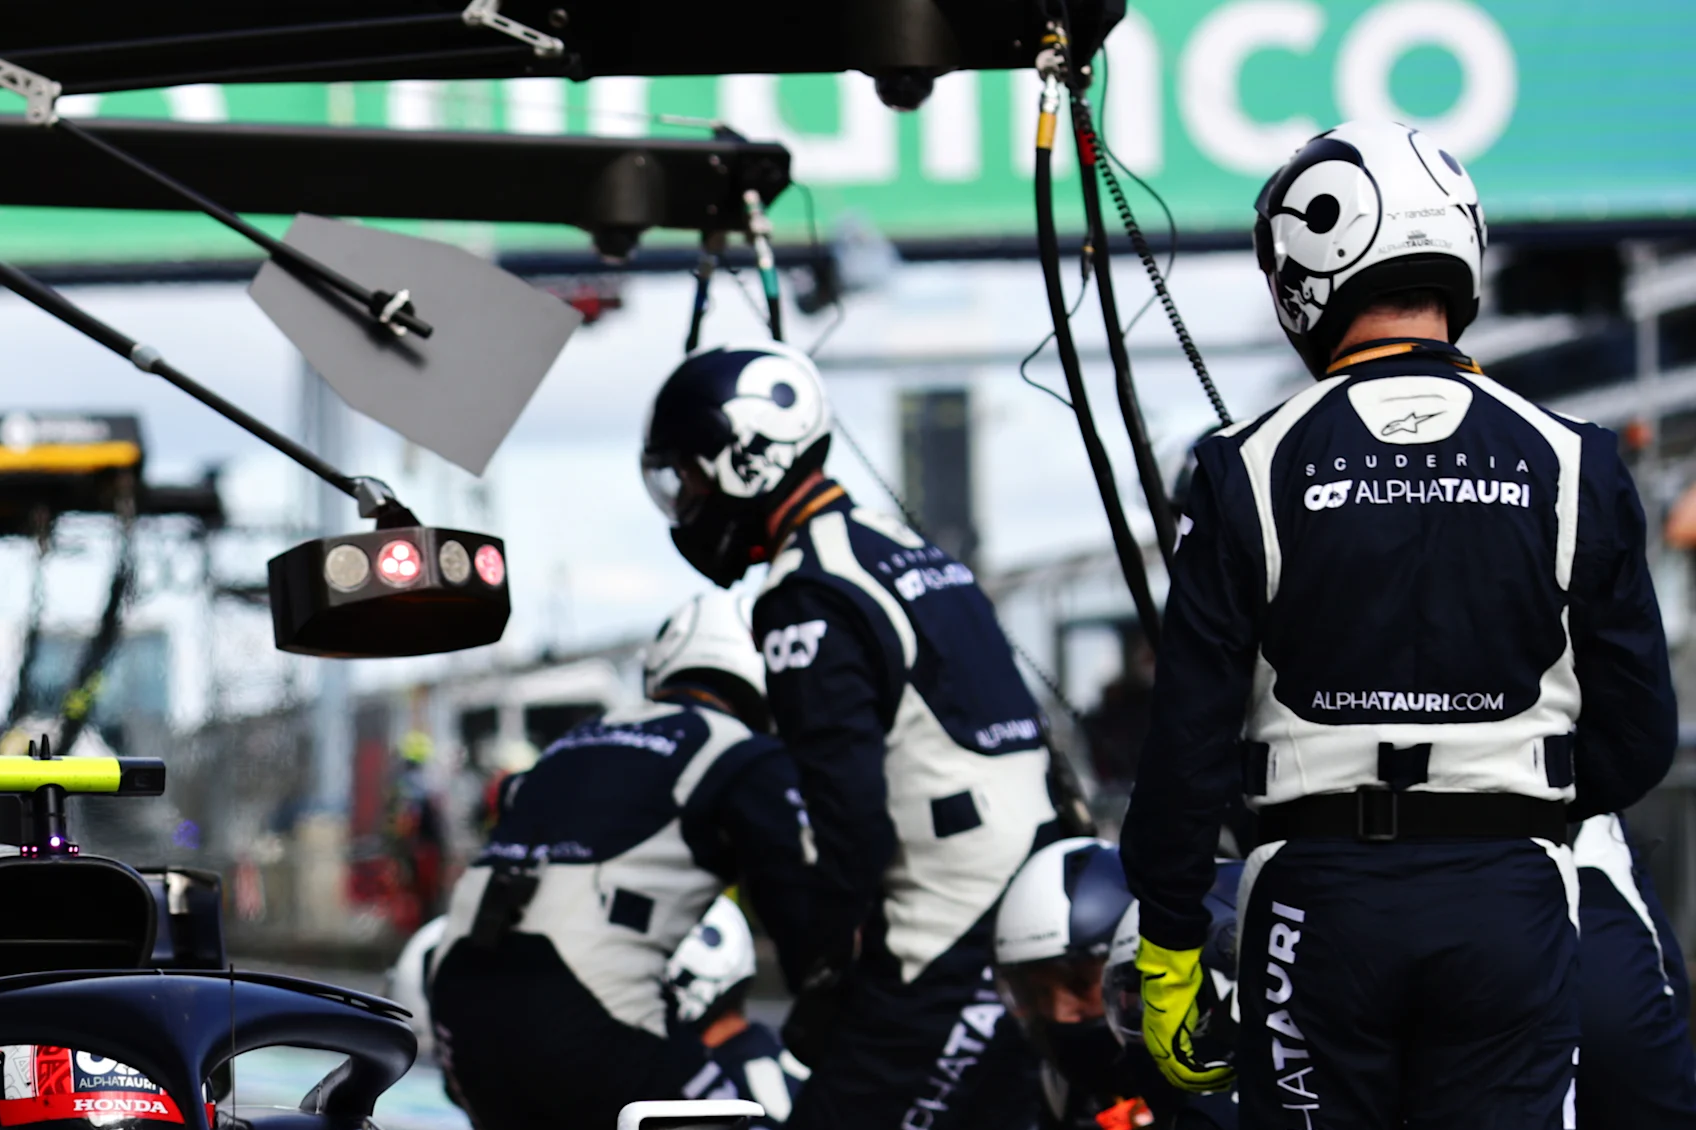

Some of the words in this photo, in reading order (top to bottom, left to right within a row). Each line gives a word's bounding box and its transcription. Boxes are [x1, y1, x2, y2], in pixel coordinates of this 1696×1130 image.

[1305, 453, 1529, 477] SCUDERIA
[1355, 478, 1530, 508] ALPHATAURI
[1311, 690, 1504, 713] ALPHATAURI.COM
[78, 1075, 157, 1091] ALPHATAURI
[73, 1098, 169, 1115] HONDA
